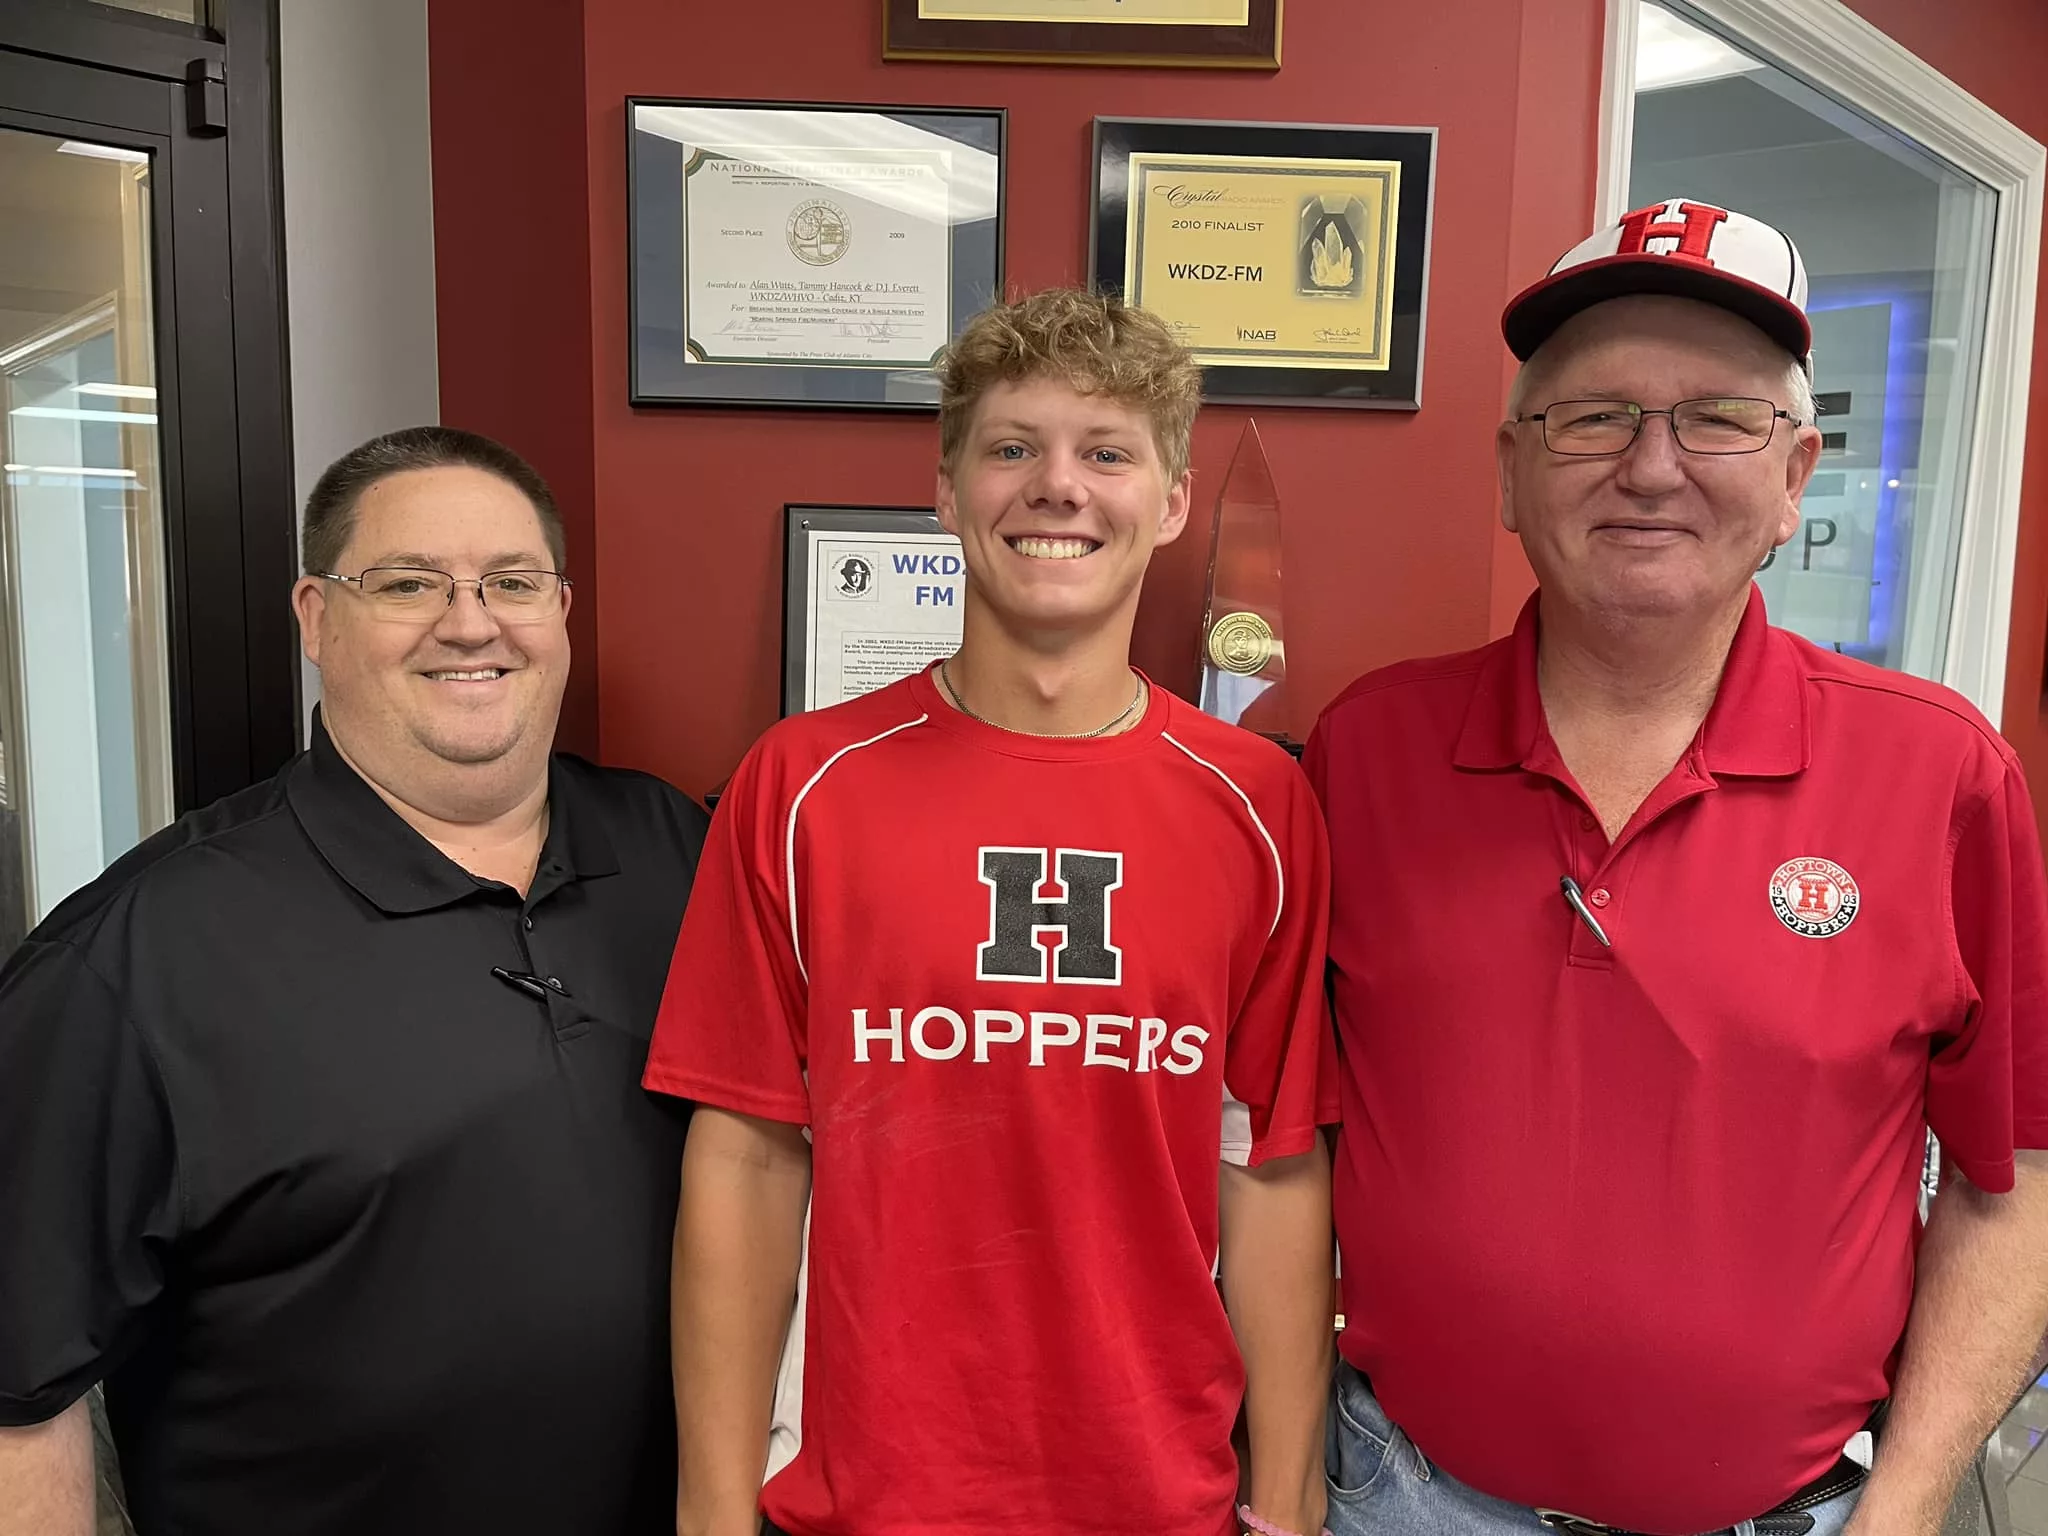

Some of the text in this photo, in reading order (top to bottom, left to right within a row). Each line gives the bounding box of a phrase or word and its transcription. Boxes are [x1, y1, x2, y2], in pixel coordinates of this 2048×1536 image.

[710, 162, 779, 174] NATIONA
[1152, 184, 1230, 210] Crystal
[1171, 219, 1265, 232] 2010 FINALIST
[1617, 203, 1728, 268] H
[1168, 263, 1263, 282] WKDZ-FM
[749, 280, 768, 289] Alan
[798, 281, 828, 293] Tammy
[830, 282, 863, 292] Hancock
[893, 283, 920, 293] Everett
[1241, 330, 1277, 340] NAB
[893, 554, 967, 575] WKD
[916, 586, 954, 606] FM
[1777, 861, 1850, 887] HOPTOWN
[976, 846, 1123, 986] H
[1775, 903, 1851, 935] HOPPERS
[851, 1006, 1211, 1075] HOPPERS
